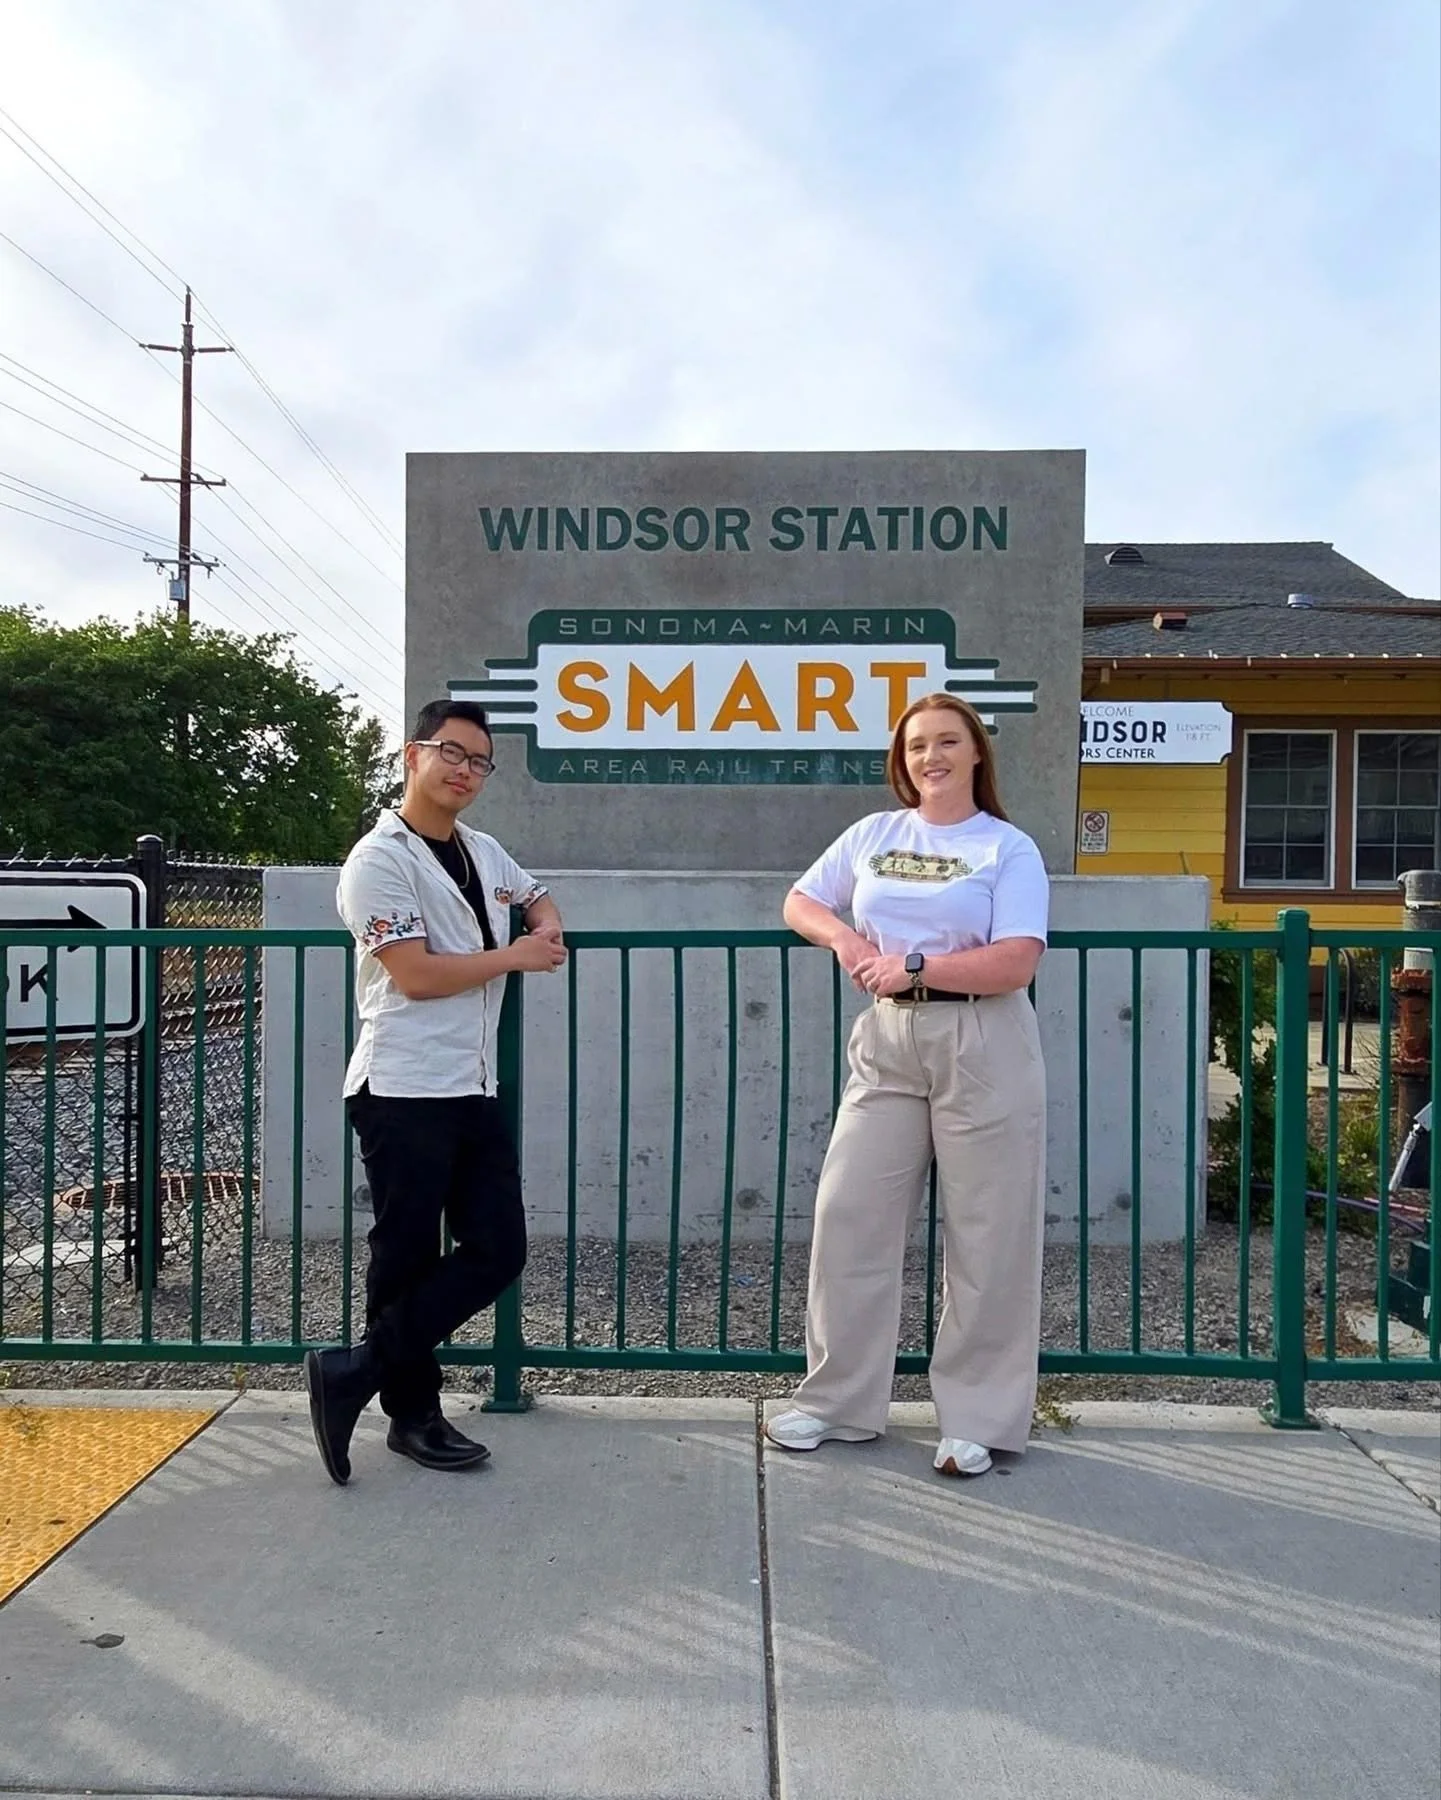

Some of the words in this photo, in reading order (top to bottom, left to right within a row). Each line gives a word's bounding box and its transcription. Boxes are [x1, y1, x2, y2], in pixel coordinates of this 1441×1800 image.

[479, 506, 750, 551] WINDSOR
[769, 506, 1008, 551] STATION
[556, 659, 927, 732] SMART
[1083, 705, 1134, 717] ELCOME
[1176, 723, 1222, 732] ELEVATION
[1106, 747, 1156, 759] CENTER
[558, 759, 648, 775] AREA
[671, 759, 750, 775] RAIL
[769, 759, 885, 775] TRANS
